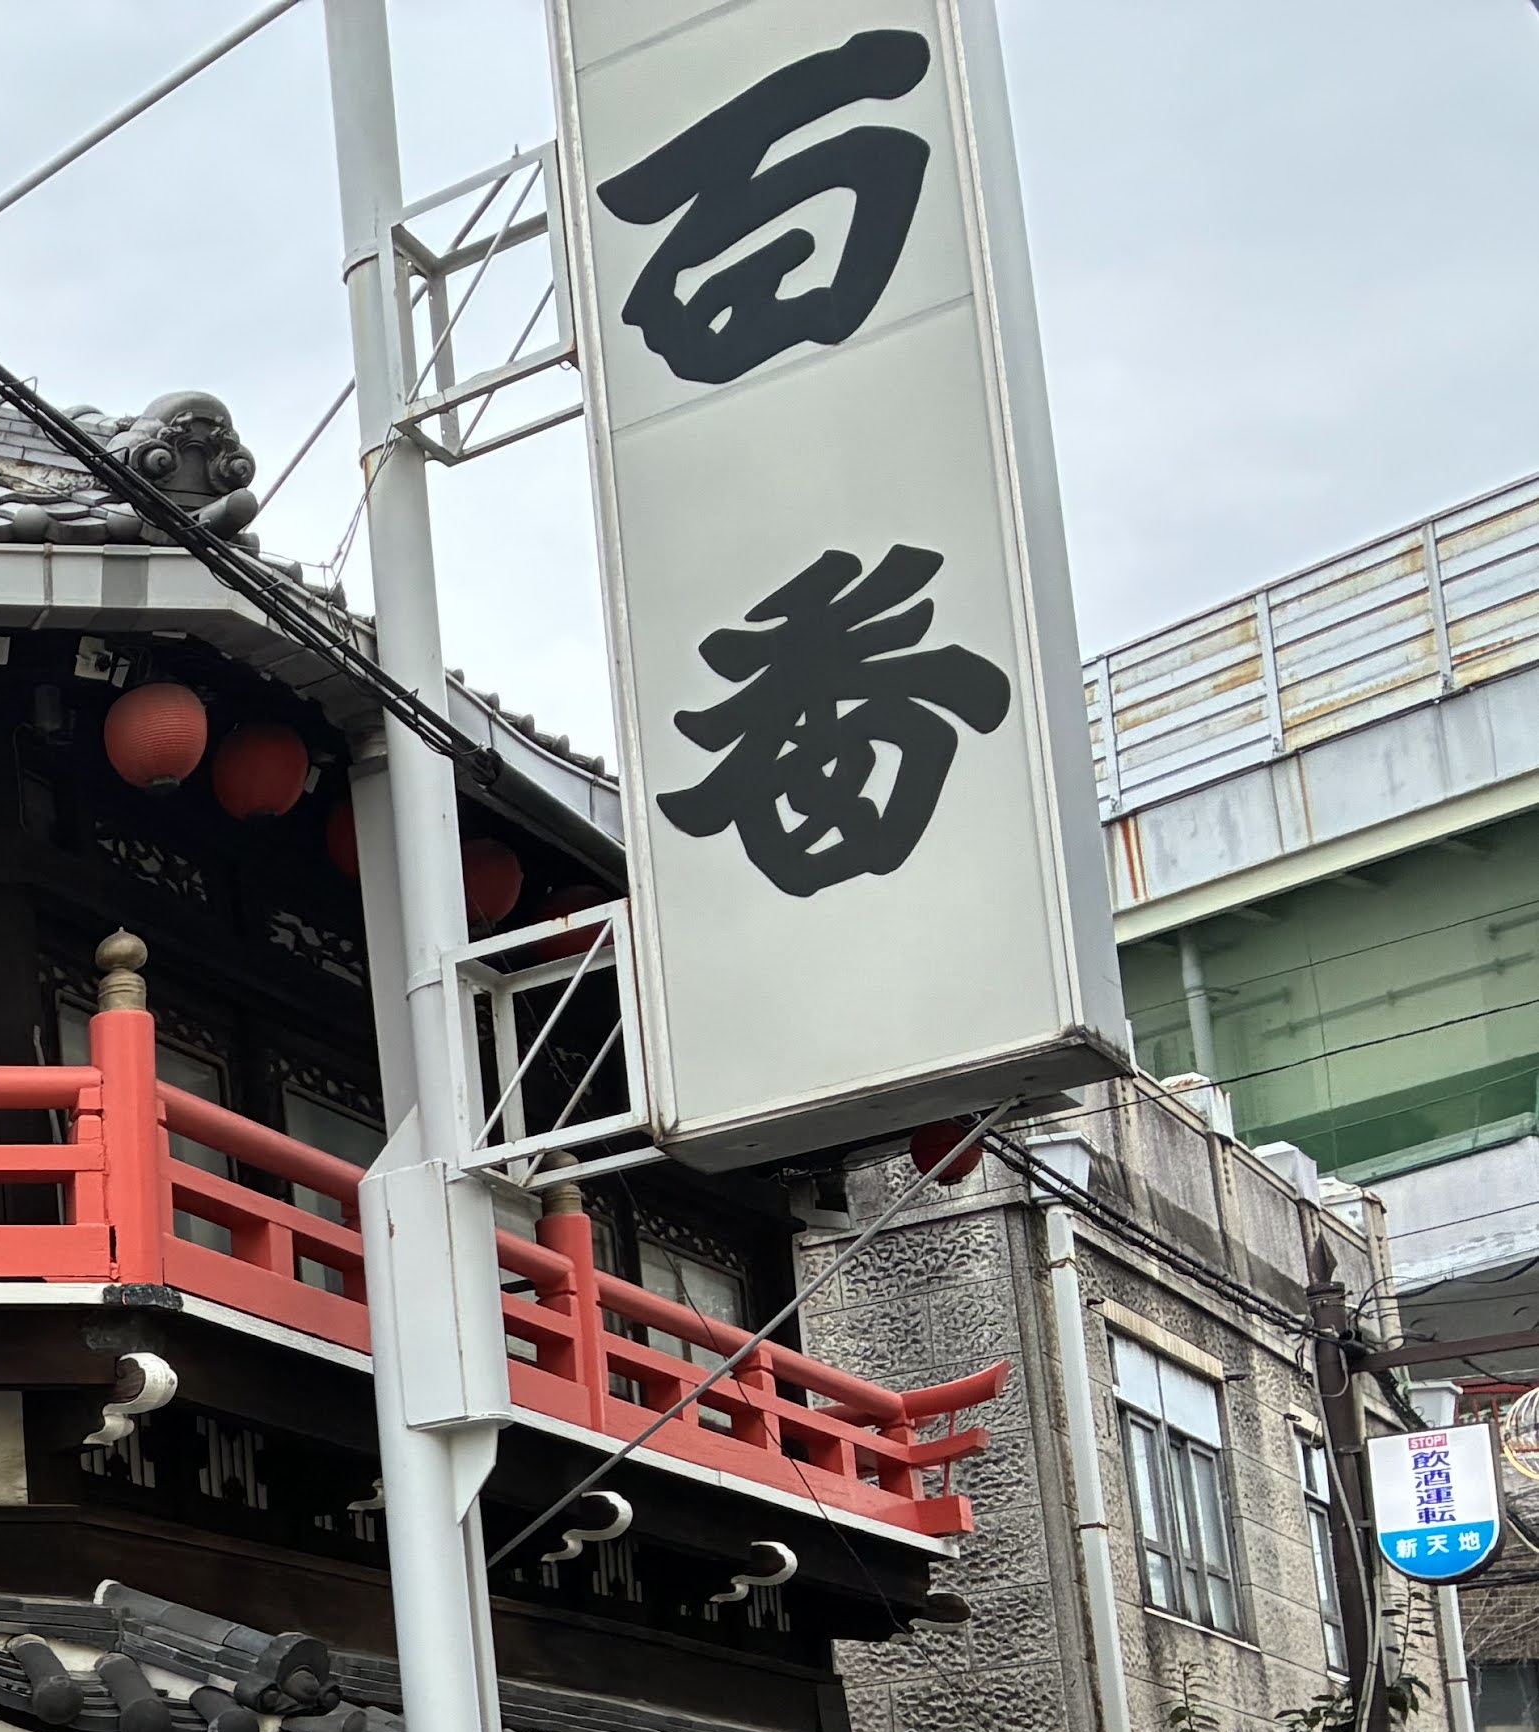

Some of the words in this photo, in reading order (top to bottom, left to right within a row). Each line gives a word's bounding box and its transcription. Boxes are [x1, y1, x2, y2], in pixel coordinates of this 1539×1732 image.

[596, 29, 1011, 897] 百番
[1411, 1450, 1457, 1525] 飲酒運転
[1396, 1530, 1482, 1559] 新天地
